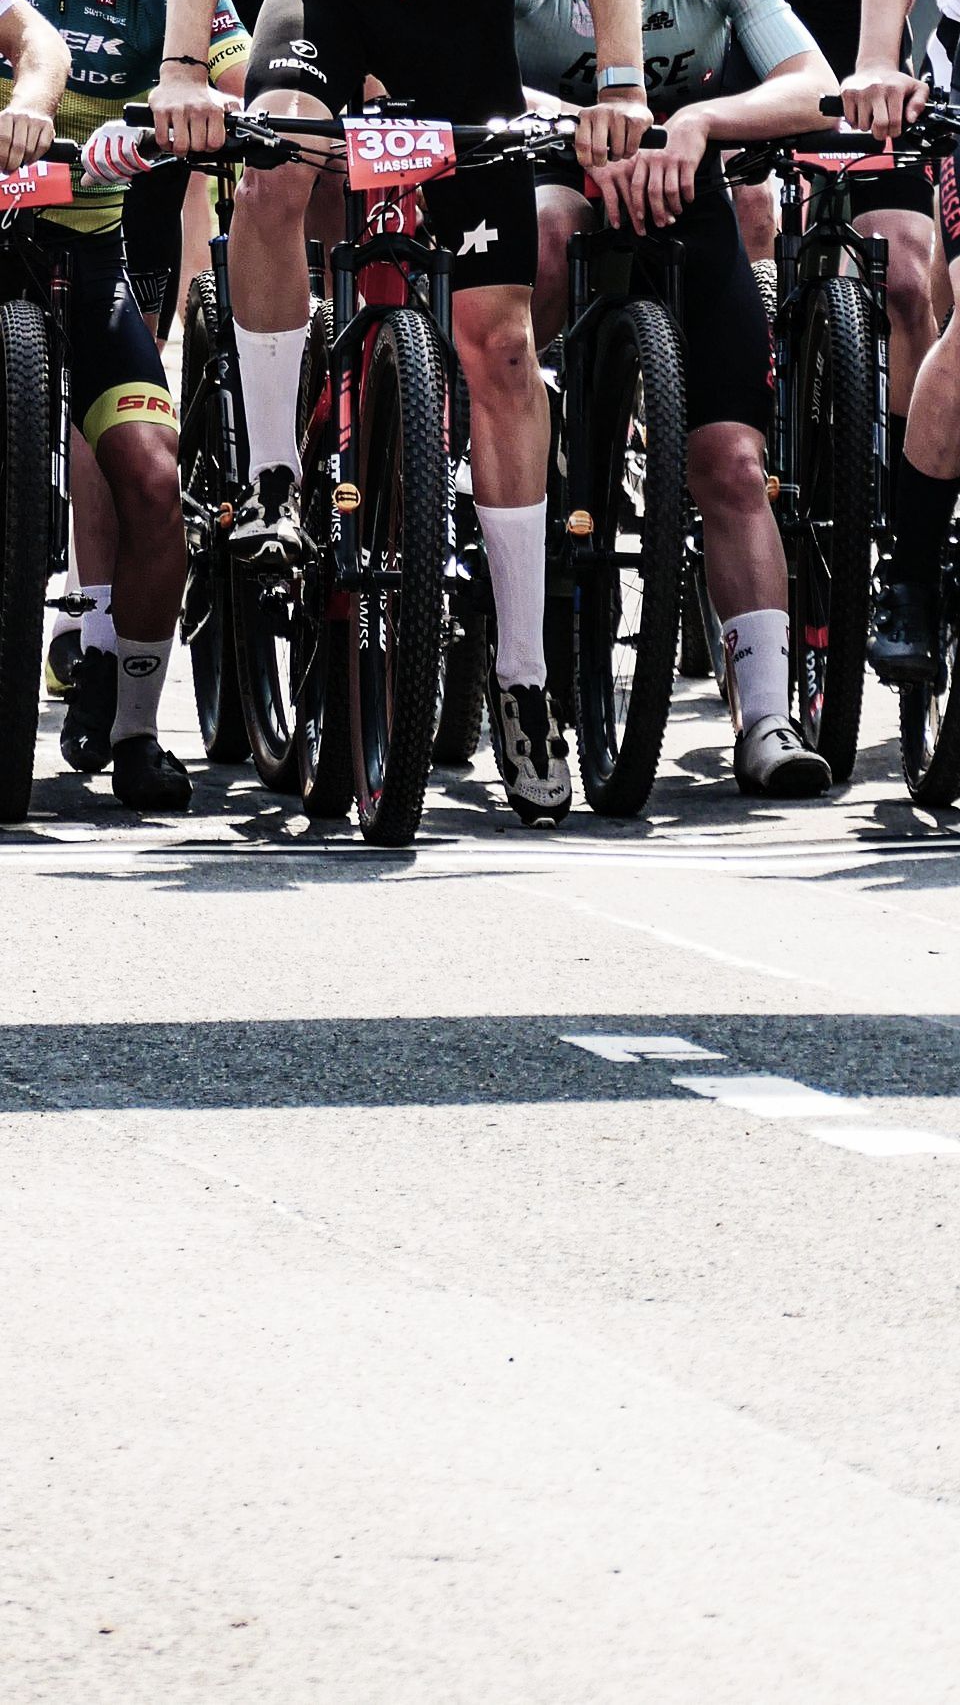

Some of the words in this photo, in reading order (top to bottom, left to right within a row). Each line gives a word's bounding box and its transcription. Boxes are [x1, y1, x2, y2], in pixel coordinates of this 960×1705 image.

[71, 69, 128, 85] UDE
[268, 57, 329, 85] maxon
[560, 49, 697, 92] RSE
[356, 130, 446, 161] 304
[373, 156, 433, 174] HASSLER
[1, 180, 36, 195] TOTH
[330, 452, 341, 484] DT
